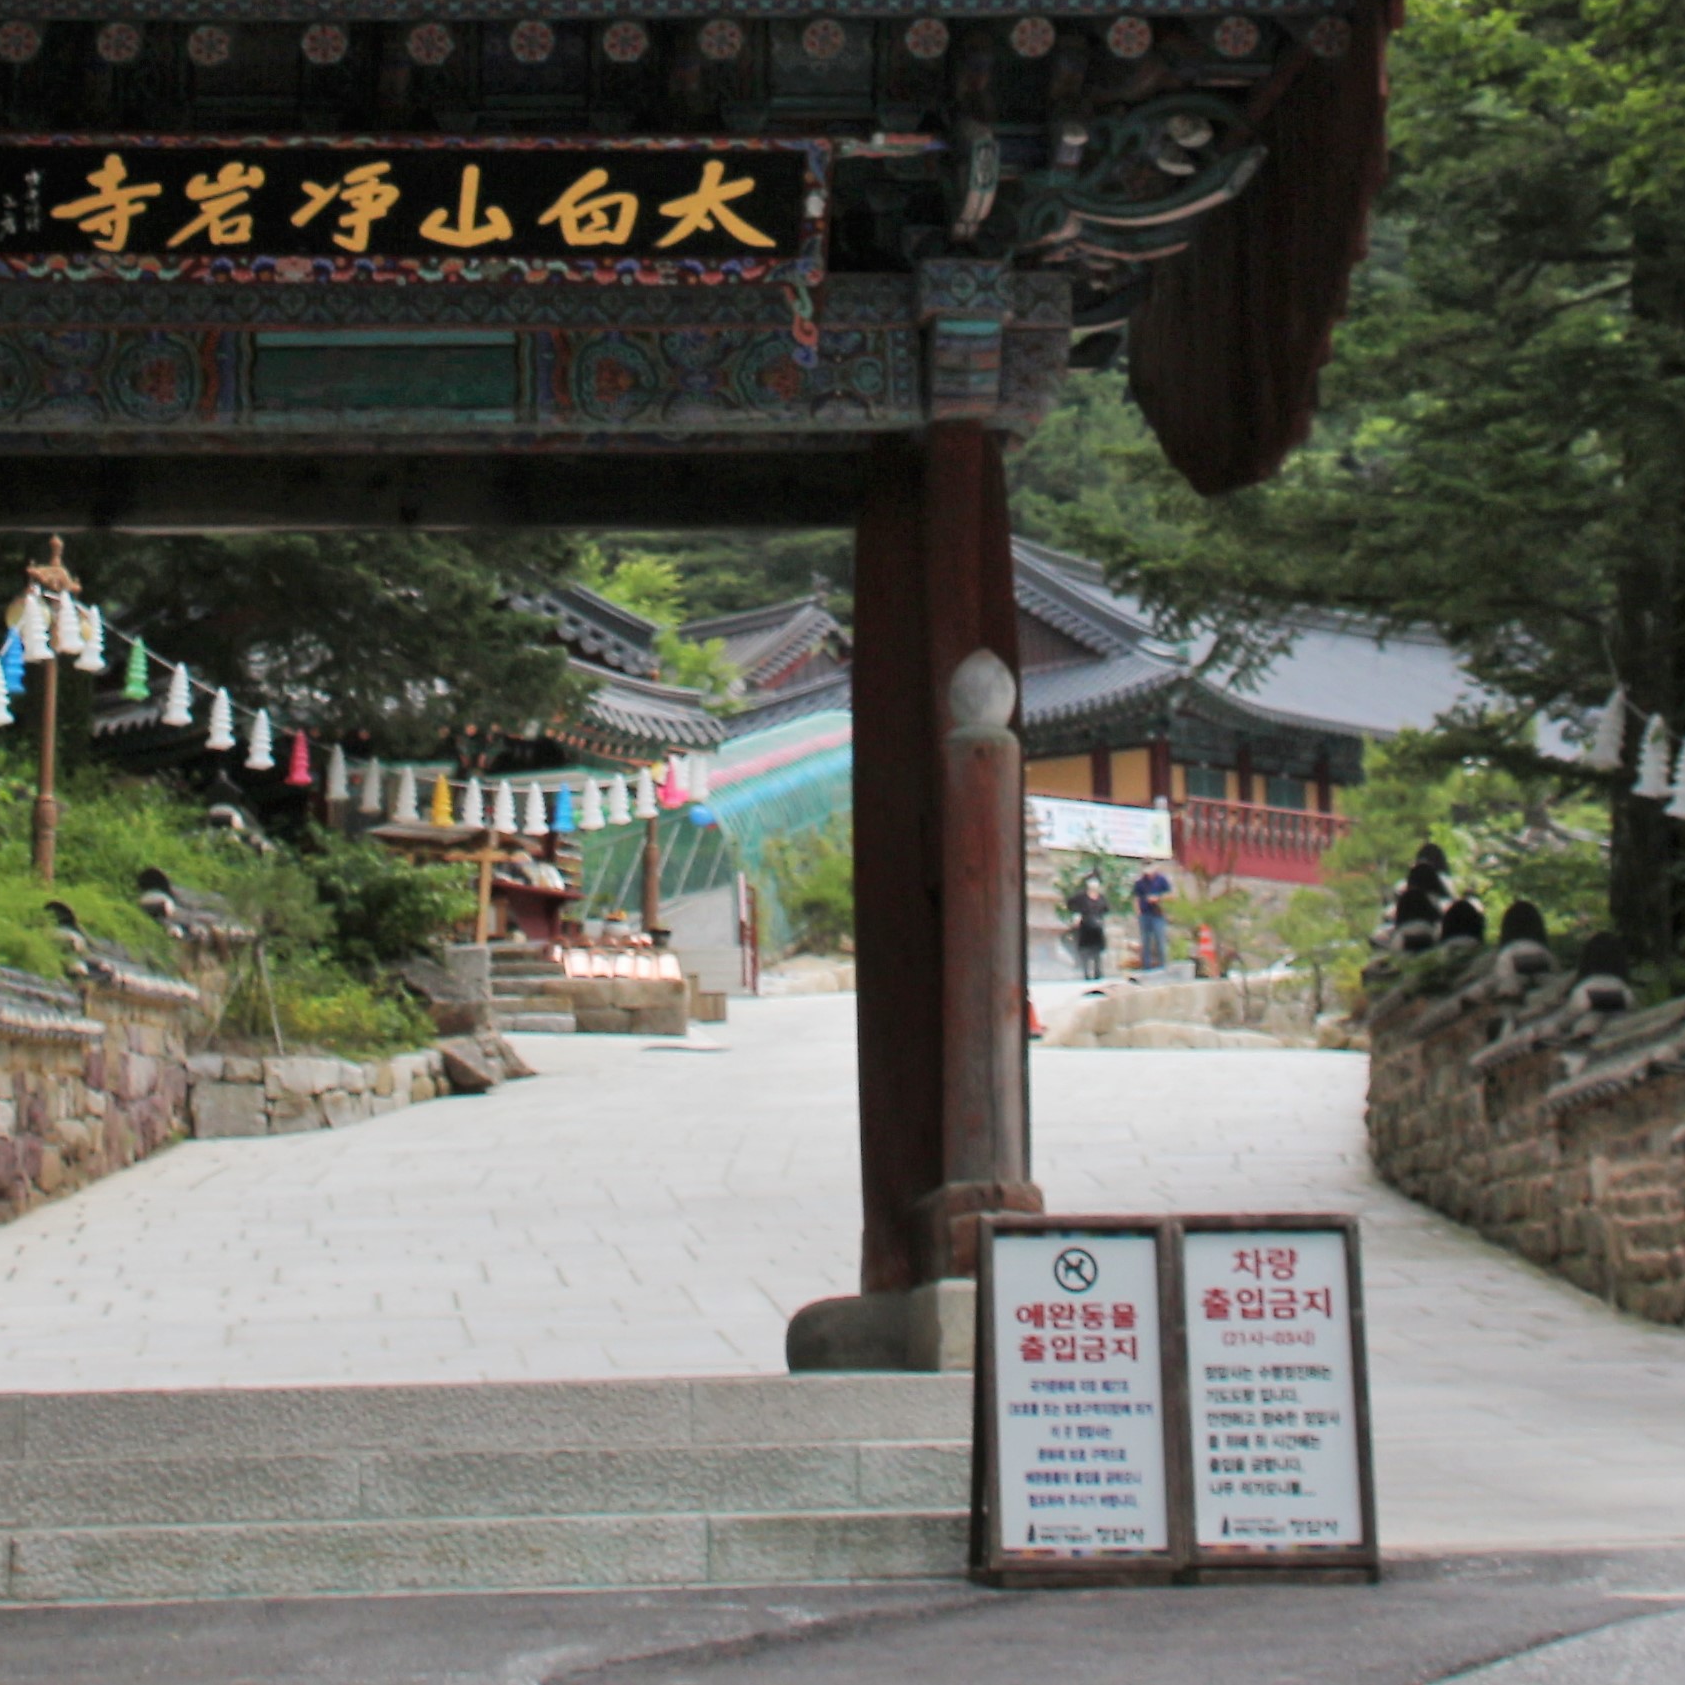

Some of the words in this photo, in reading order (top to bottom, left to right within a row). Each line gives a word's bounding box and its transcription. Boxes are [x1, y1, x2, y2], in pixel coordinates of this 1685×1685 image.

[1232, 1247, 1297, 1281] 차량
[1016, 1302, 1138, 1330] 애완동물
[1202, 1286, 1332, 1320] 출입금지
[1020, 1335, 1138, 1363] 출입금지
